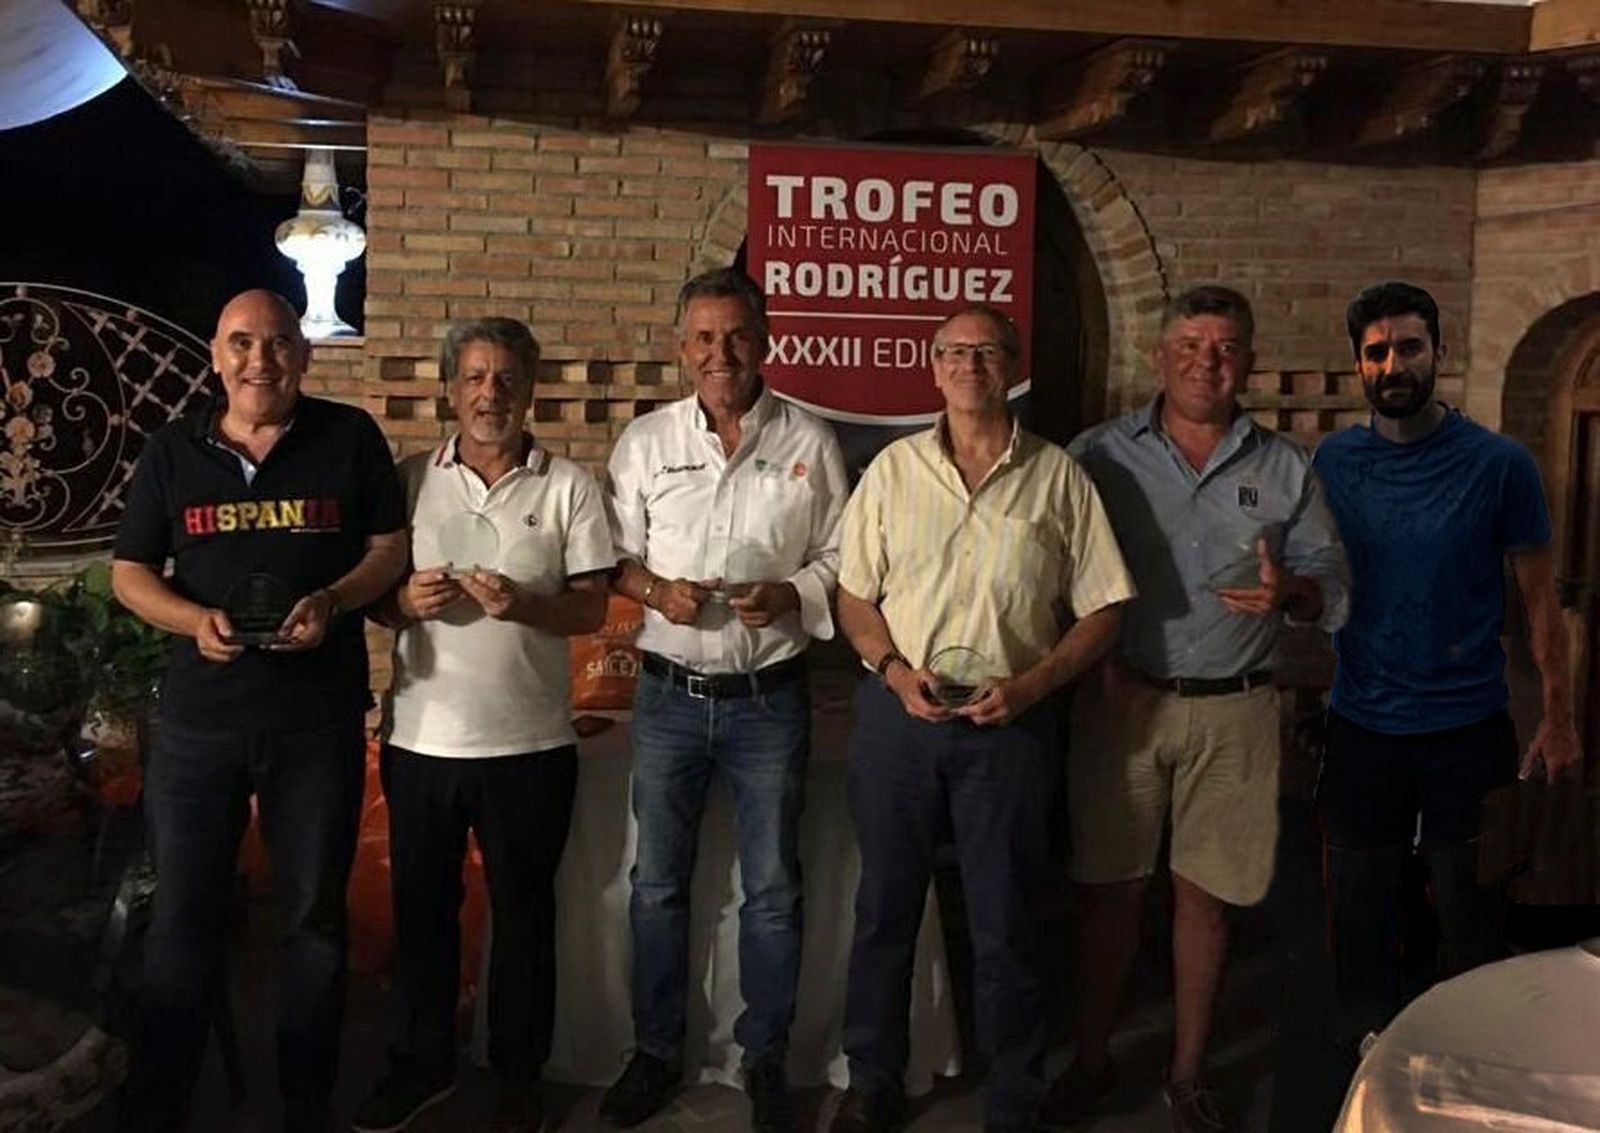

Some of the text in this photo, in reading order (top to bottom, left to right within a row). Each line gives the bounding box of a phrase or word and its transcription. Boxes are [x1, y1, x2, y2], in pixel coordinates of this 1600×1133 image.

[765, 174, 1019, 227] TROFEO
[766, 225, 1008, 255] INTERNACIONAL
[764, 254, 1014, 303] RODRÍGUEZ
[764, 334, 928, 368] XXXII EDI
